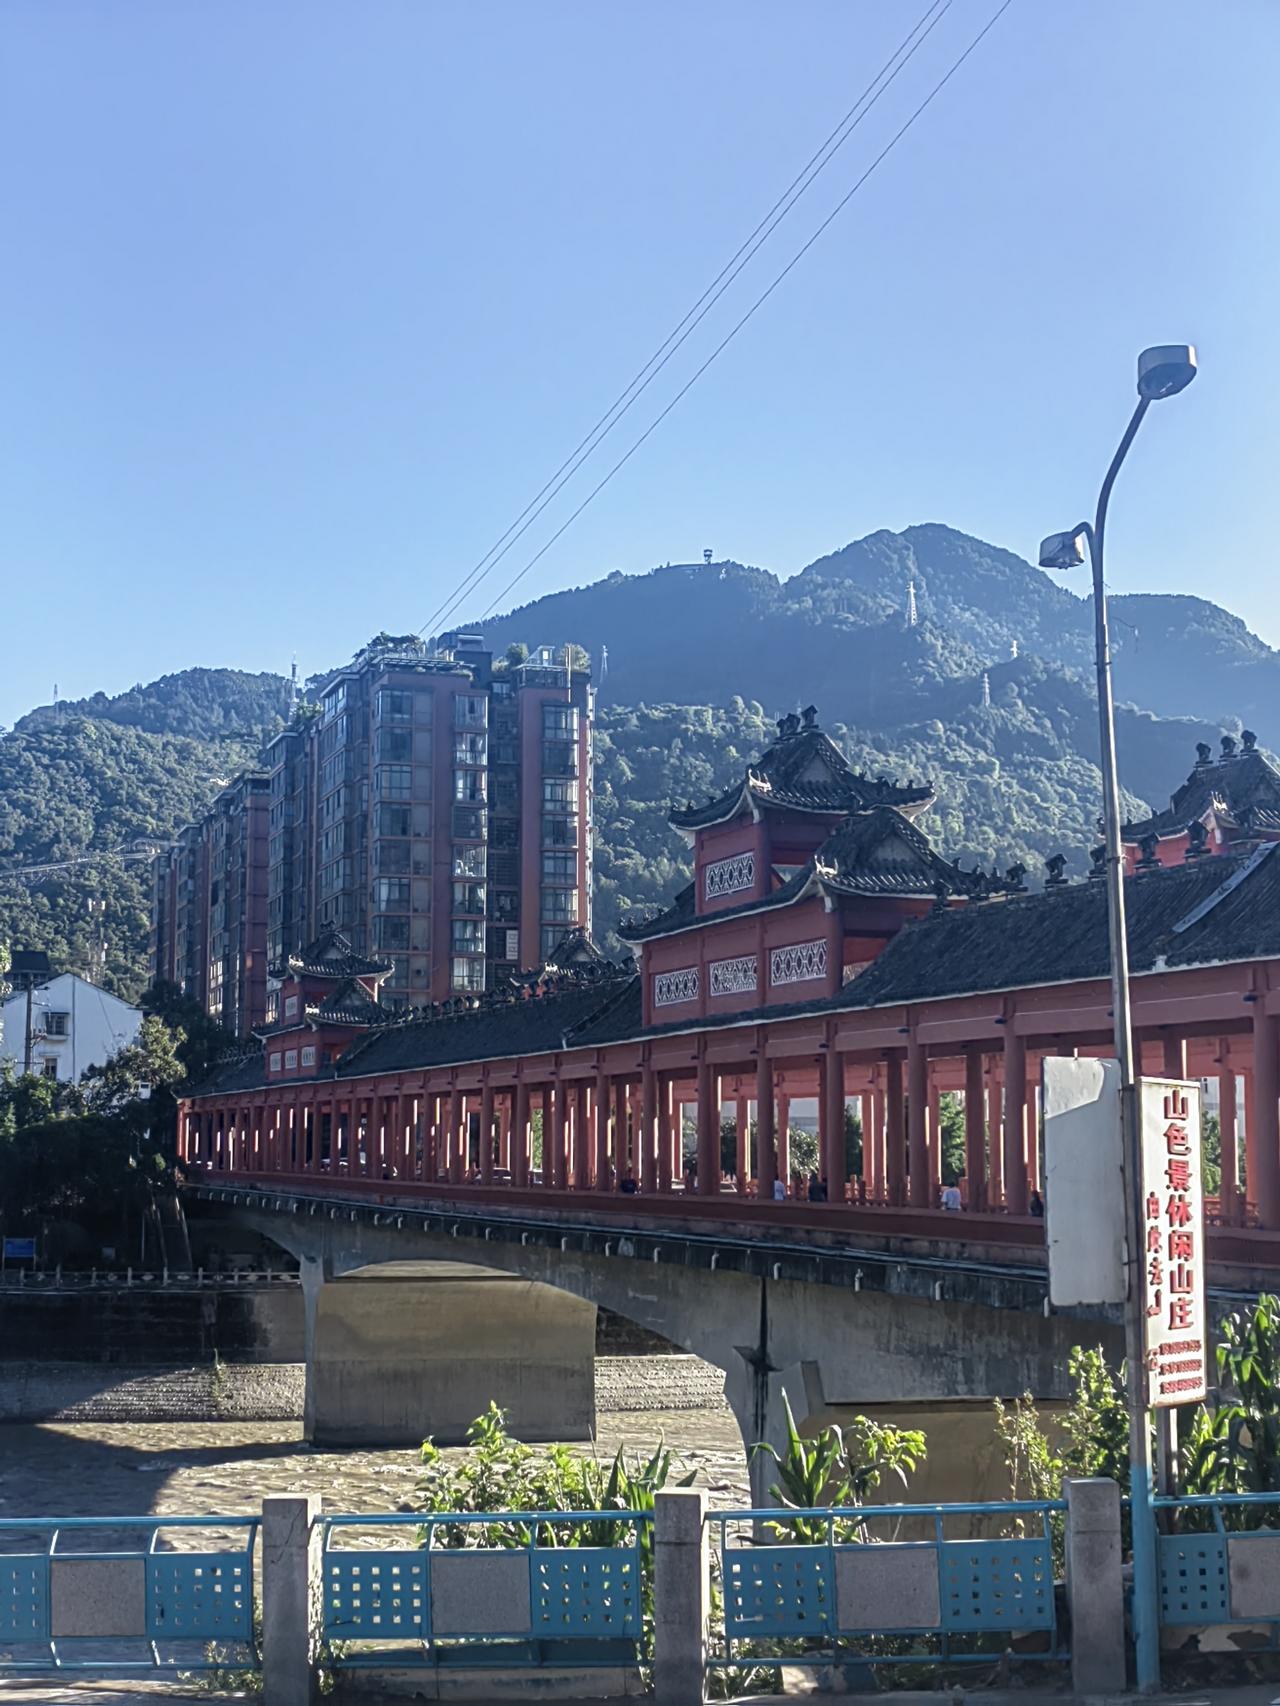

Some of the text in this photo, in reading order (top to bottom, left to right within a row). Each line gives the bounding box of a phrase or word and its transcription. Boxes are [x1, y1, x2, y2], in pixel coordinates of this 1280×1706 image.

[1163, 1090, 1194, 1330] 山色景休闲山庄
